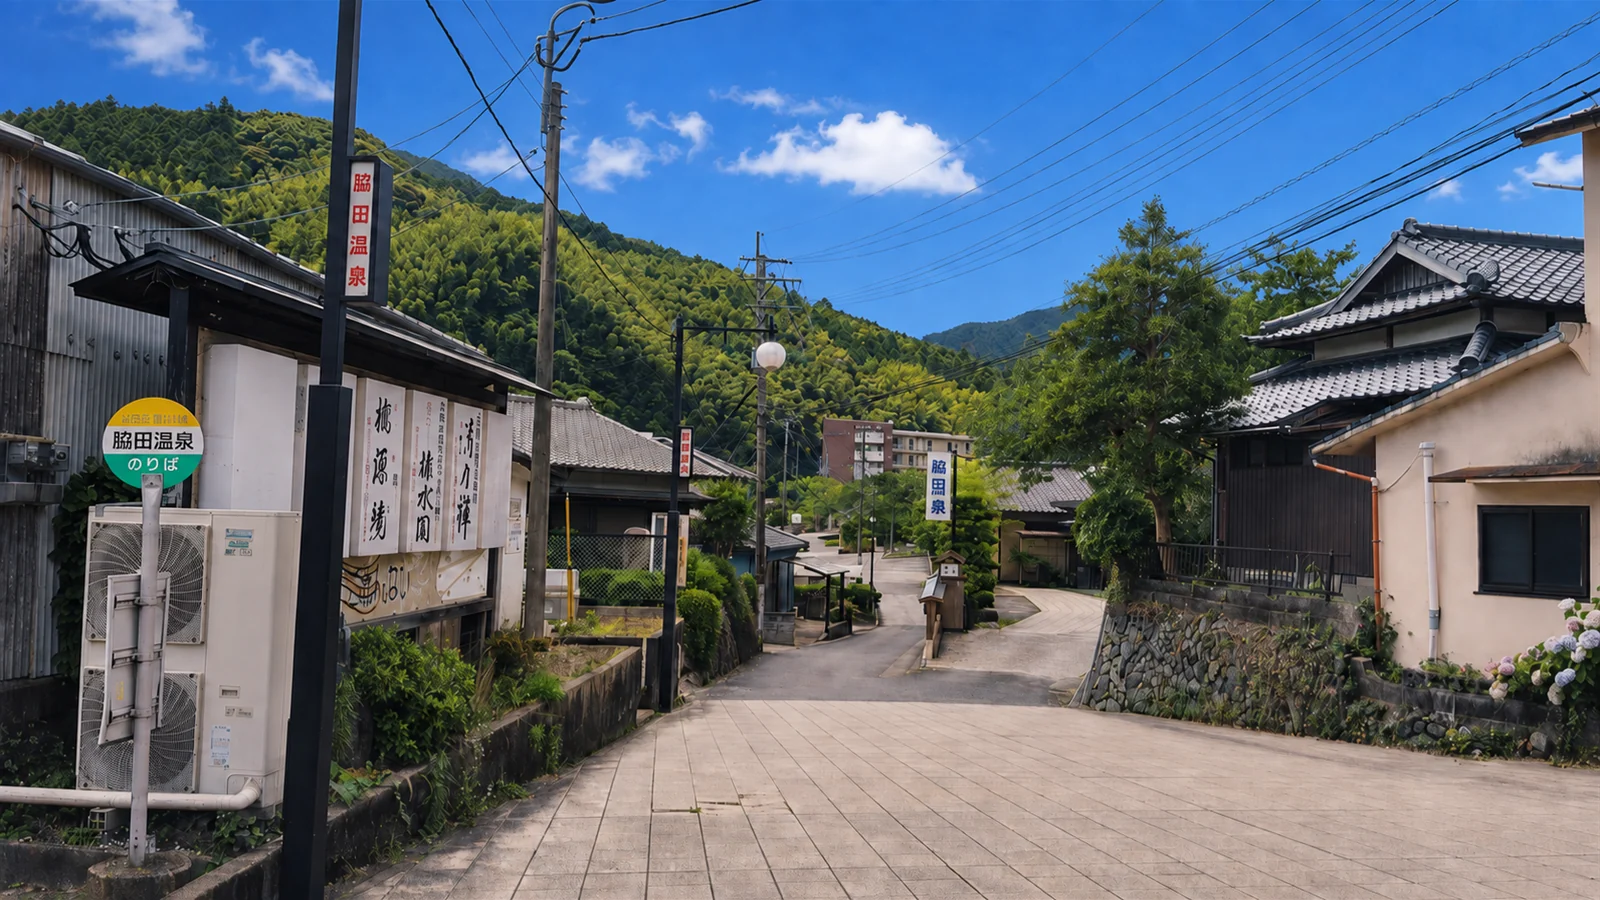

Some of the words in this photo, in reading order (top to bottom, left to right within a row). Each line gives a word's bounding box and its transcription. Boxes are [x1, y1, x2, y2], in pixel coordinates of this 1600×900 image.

[348, 173, 372, 287] 脇田温泉
[112, 431, 194, 450] 脇田温泉
[127, 457, 179, 471] のりば
